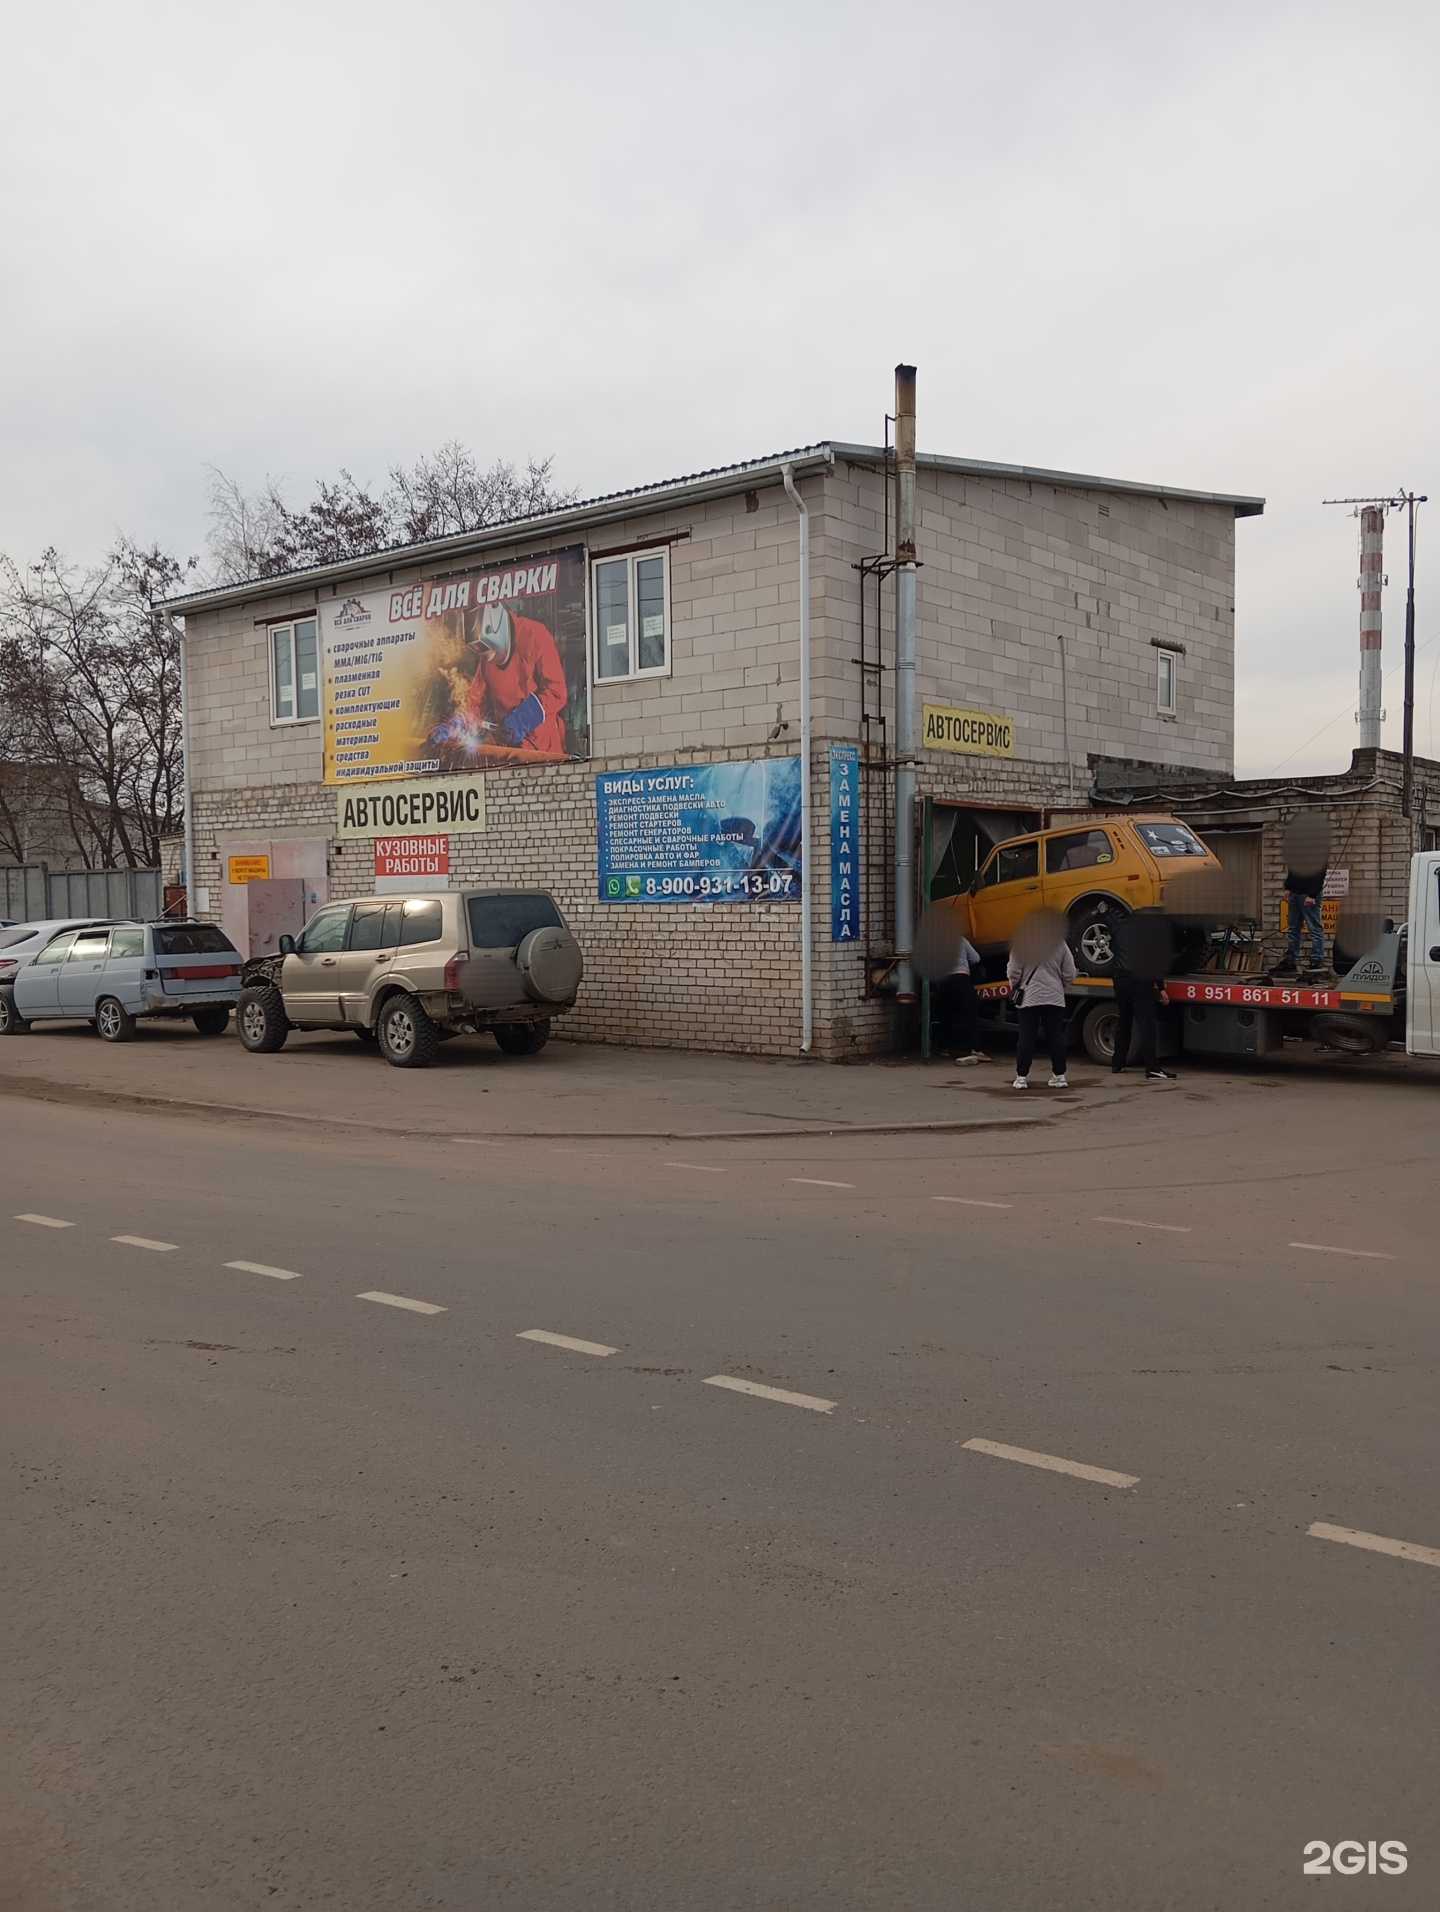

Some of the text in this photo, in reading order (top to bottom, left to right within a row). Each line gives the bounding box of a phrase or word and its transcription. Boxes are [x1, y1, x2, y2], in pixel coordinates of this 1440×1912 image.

[390, 563, 558, 621] ВСЁ ДЛЯ СВАРКИ
[333, 632, 416, 653] сварочные аппараты
[335, 670, 380, 684] плазменная
[335, 689, 356, 701] резка
[336, 700, 400, 715] комплектующие
[336, 719, 377, 732] расходные
[926, 714, 1011, 748] АВТОСЕРВИС
[336, 734, 379, 746] материалы
[336, 751, 369, 762] средства
[336, 760, 439, 777] индивидуальной защиты
[604, 776, 694, 795] ВИДЫ УСЛУГ:
[648, 794, 678, 803] ЗАМЕНА
[678, 793, 705, 802] МАСЛА
[344, 788, 480, 828] АВТОСЕРВИС
[608, 800, 726, 814] ДИАГНОСТИКА ПОДВЕСКИ АВТО
[608, 812, 679, 822] РЕМОНТ ПОДВЕСКИ
[609, 820, 682, 830] РЕМОНТ СТАРТЕРОВ
[609, 828, 692, 838] РЕМОНТ ГЕНЕРАТОРОВ
[610, 833, 744, 846] СЛЕСАРНЫЕ И СВАРОЧНЫЕ РАБОТЫ
[376, 838, 446, 856] КУЗОВНЫЕ
[610, 844, 698, 854] ПОКРАСОЧНЫЕ РАБОТЫ
[839, 764, 851, 936] ЗАМЕНА МАСЛА
[654, 852, 674, 860] АВТО
[386, 857, 438, 873] РАБОТЫ
[610, 861, 638, 869] ЗАМЕНА
[648, 860, 678, 868] РЕМОНТ
[679, 859, 720, 867] БАМПЕРОВ
[646, 874, 793, 895] 8-900-931-13-07
[1186, 986, 1329, 1006] 8 951 861 51 11
